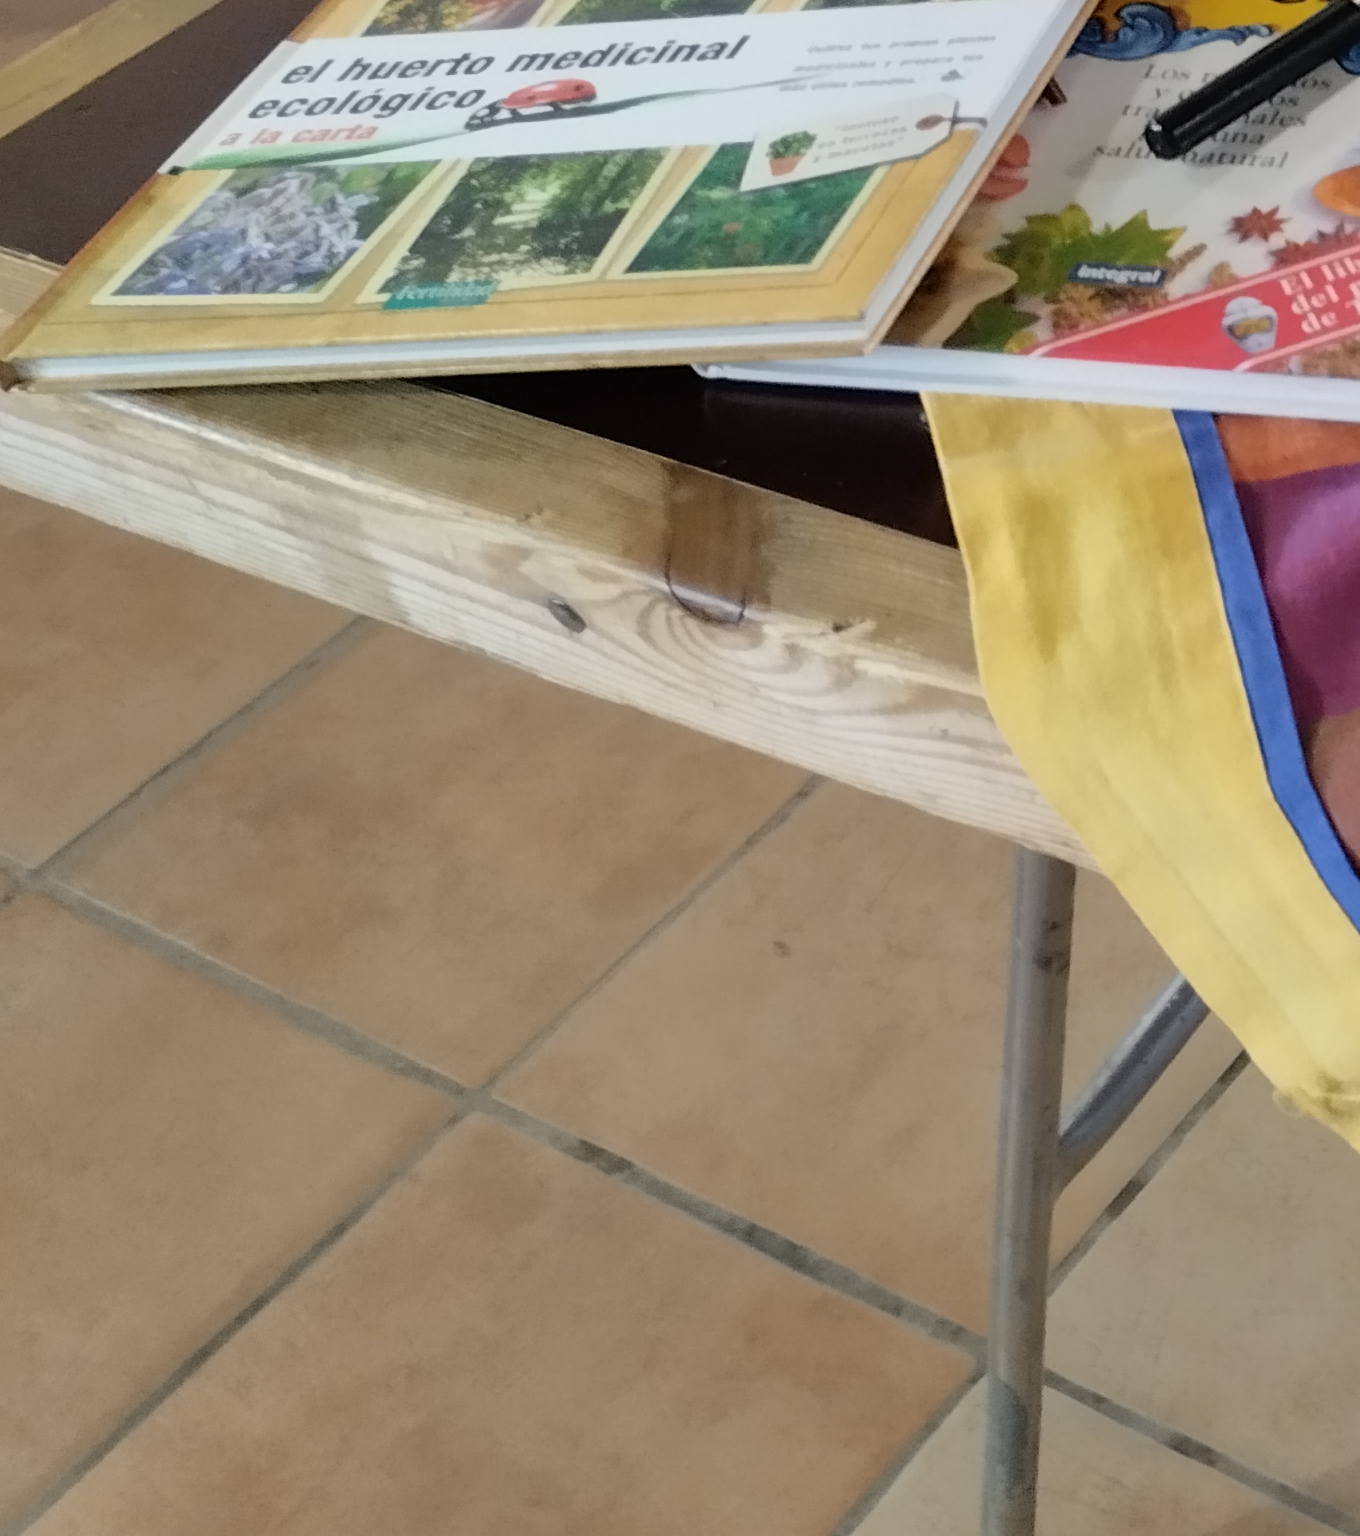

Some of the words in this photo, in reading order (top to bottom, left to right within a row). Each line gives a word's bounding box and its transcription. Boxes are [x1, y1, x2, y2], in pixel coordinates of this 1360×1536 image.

[281, 58, 334, 85] el
[337, 54, 497, 84] huerto
[504, 35, 751, 74] medicinal
[1143, 63, 1192, 81] Los
[246, 85, 488, 123] ecológico
[218, 132, 242, 148] a
[248, 125, 284, 146] la
[291, 121, 379, 146] carta
[1182, 150, 1290, 170] natural
[1278, 269, 1315, 296] El
[1290, 283, 1341, 317] del
[1301, 310, 1338, 335] de
